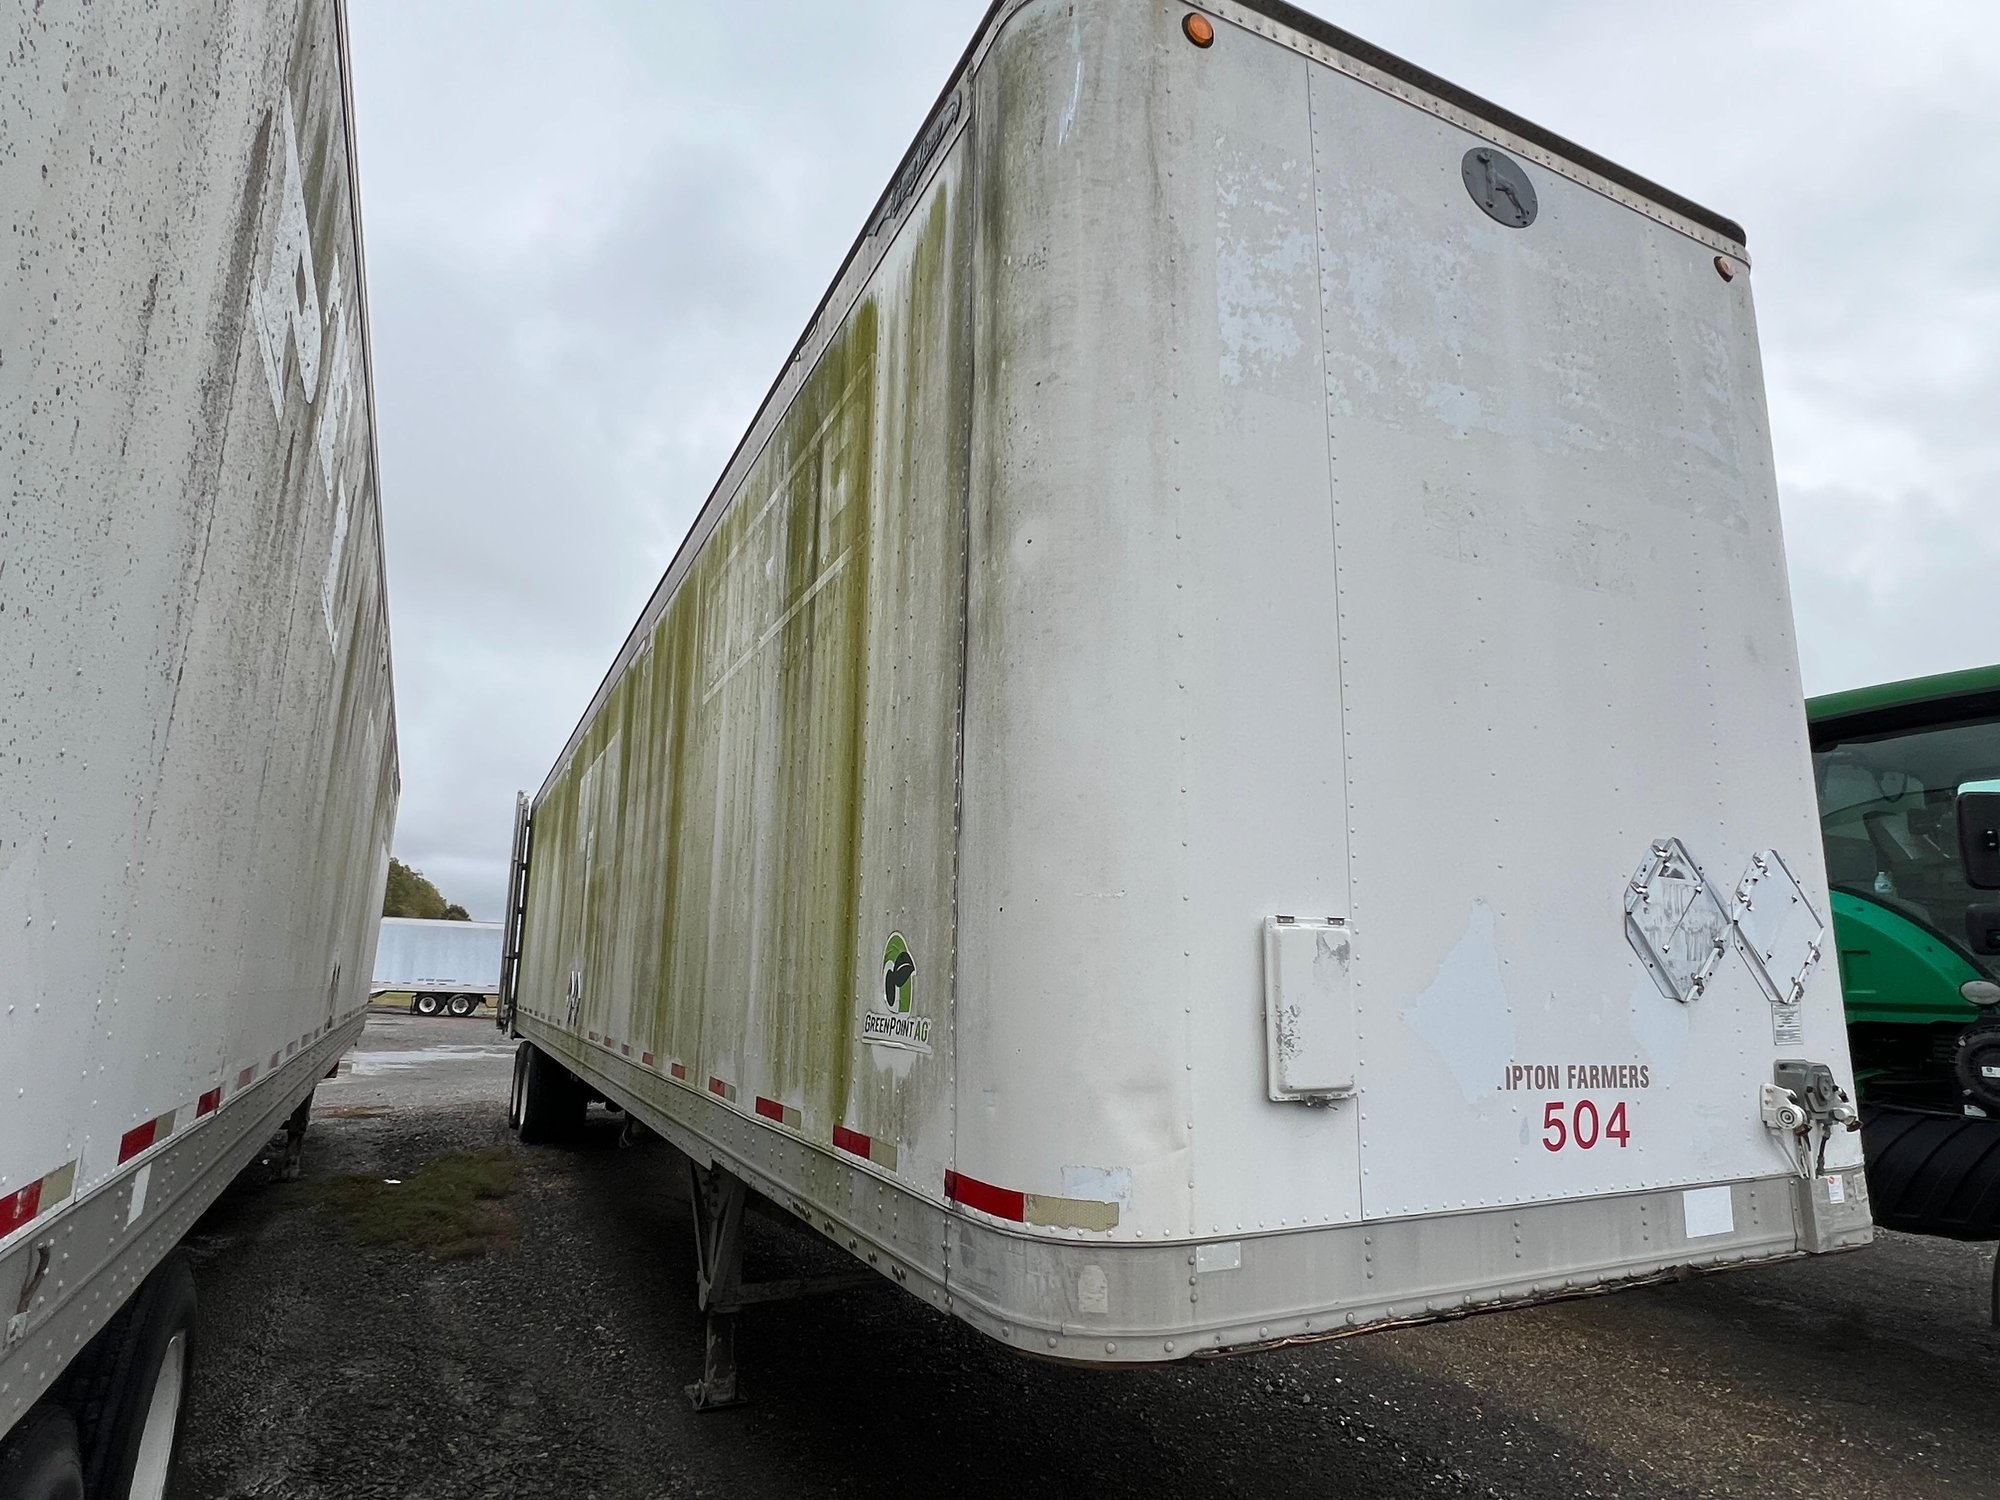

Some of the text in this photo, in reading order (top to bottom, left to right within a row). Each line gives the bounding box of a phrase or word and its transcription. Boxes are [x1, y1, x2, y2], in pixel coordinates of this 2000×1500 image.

[914, 1020, 929, 1042] AG
[1567, 1065, 1649, 1089] FARMERS
[1542, 1099, 1630, 1152] 504
